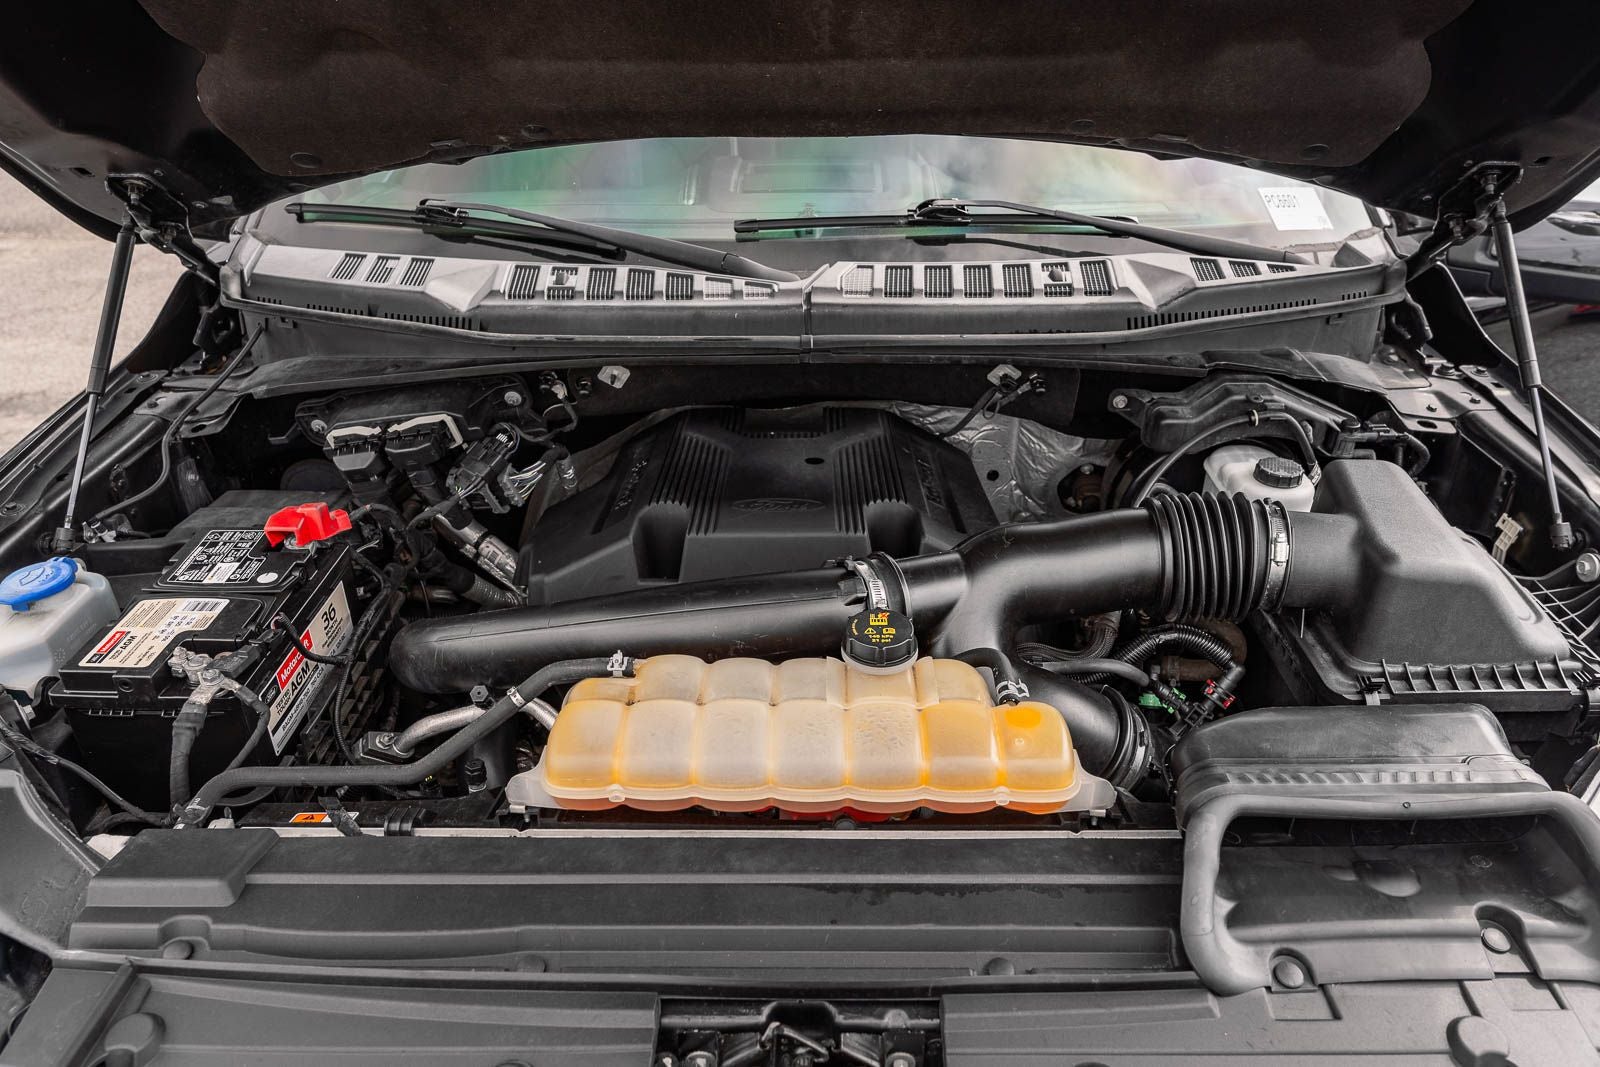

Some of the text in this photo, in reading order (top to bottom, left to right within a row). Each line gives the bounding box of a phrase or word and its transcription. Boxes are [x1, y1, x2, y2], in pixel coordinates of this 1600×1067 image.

[321, 603, 336, 631] 36
[326, 617, 338, 636] MONTH
[120, 635, 138, 649] AGM
[280, 639, 310, 682] Motorcft
[291, 661, 311, 696] AGM
